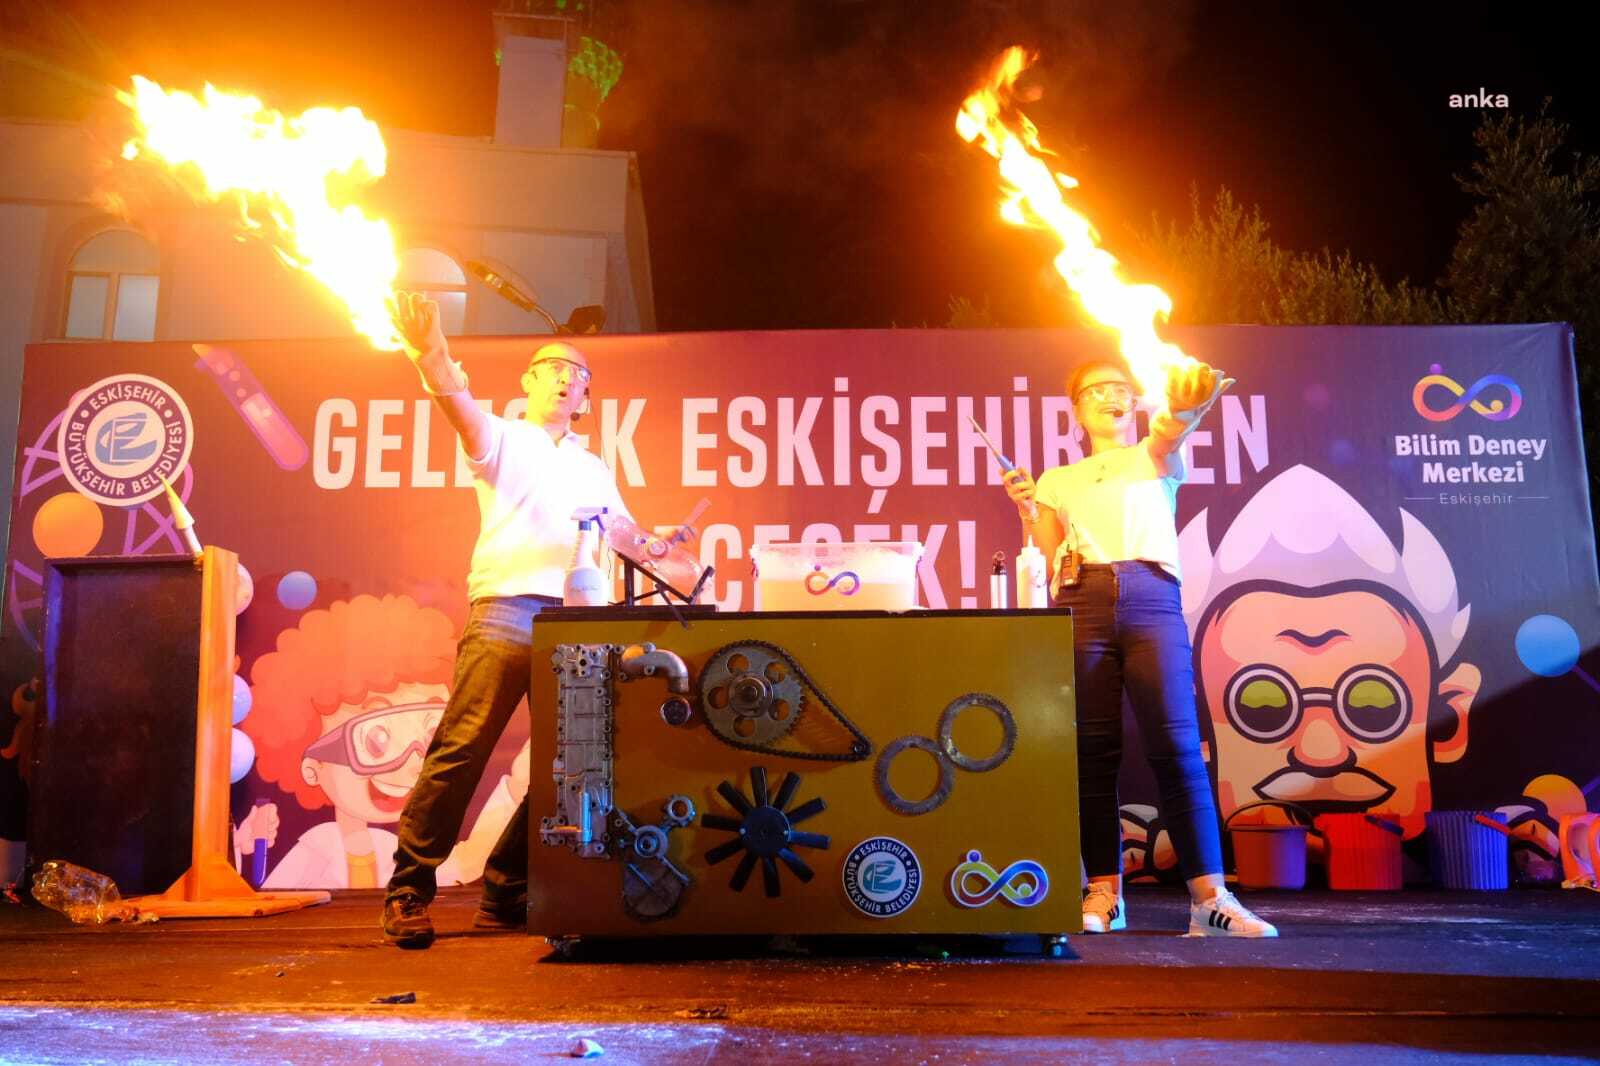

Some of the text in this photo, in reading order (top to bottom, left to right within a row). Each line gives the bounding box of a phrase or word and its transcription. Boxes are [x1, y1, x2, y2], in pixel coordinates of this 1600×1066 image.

[89, 383, 166, 411] ESKİŞEHİR
[68, 420, 183, 496] BÜYÜKŞEHİR BELEDİYESİ
[312, 376, 1270, 514] GELK ESKİŞEHİREN
[1394, 434, 1547, 461] Bilim Deney
[1422, 461, 1525, 484] Merkezi
[1439, 492, 1513, 506] Eskişehir
